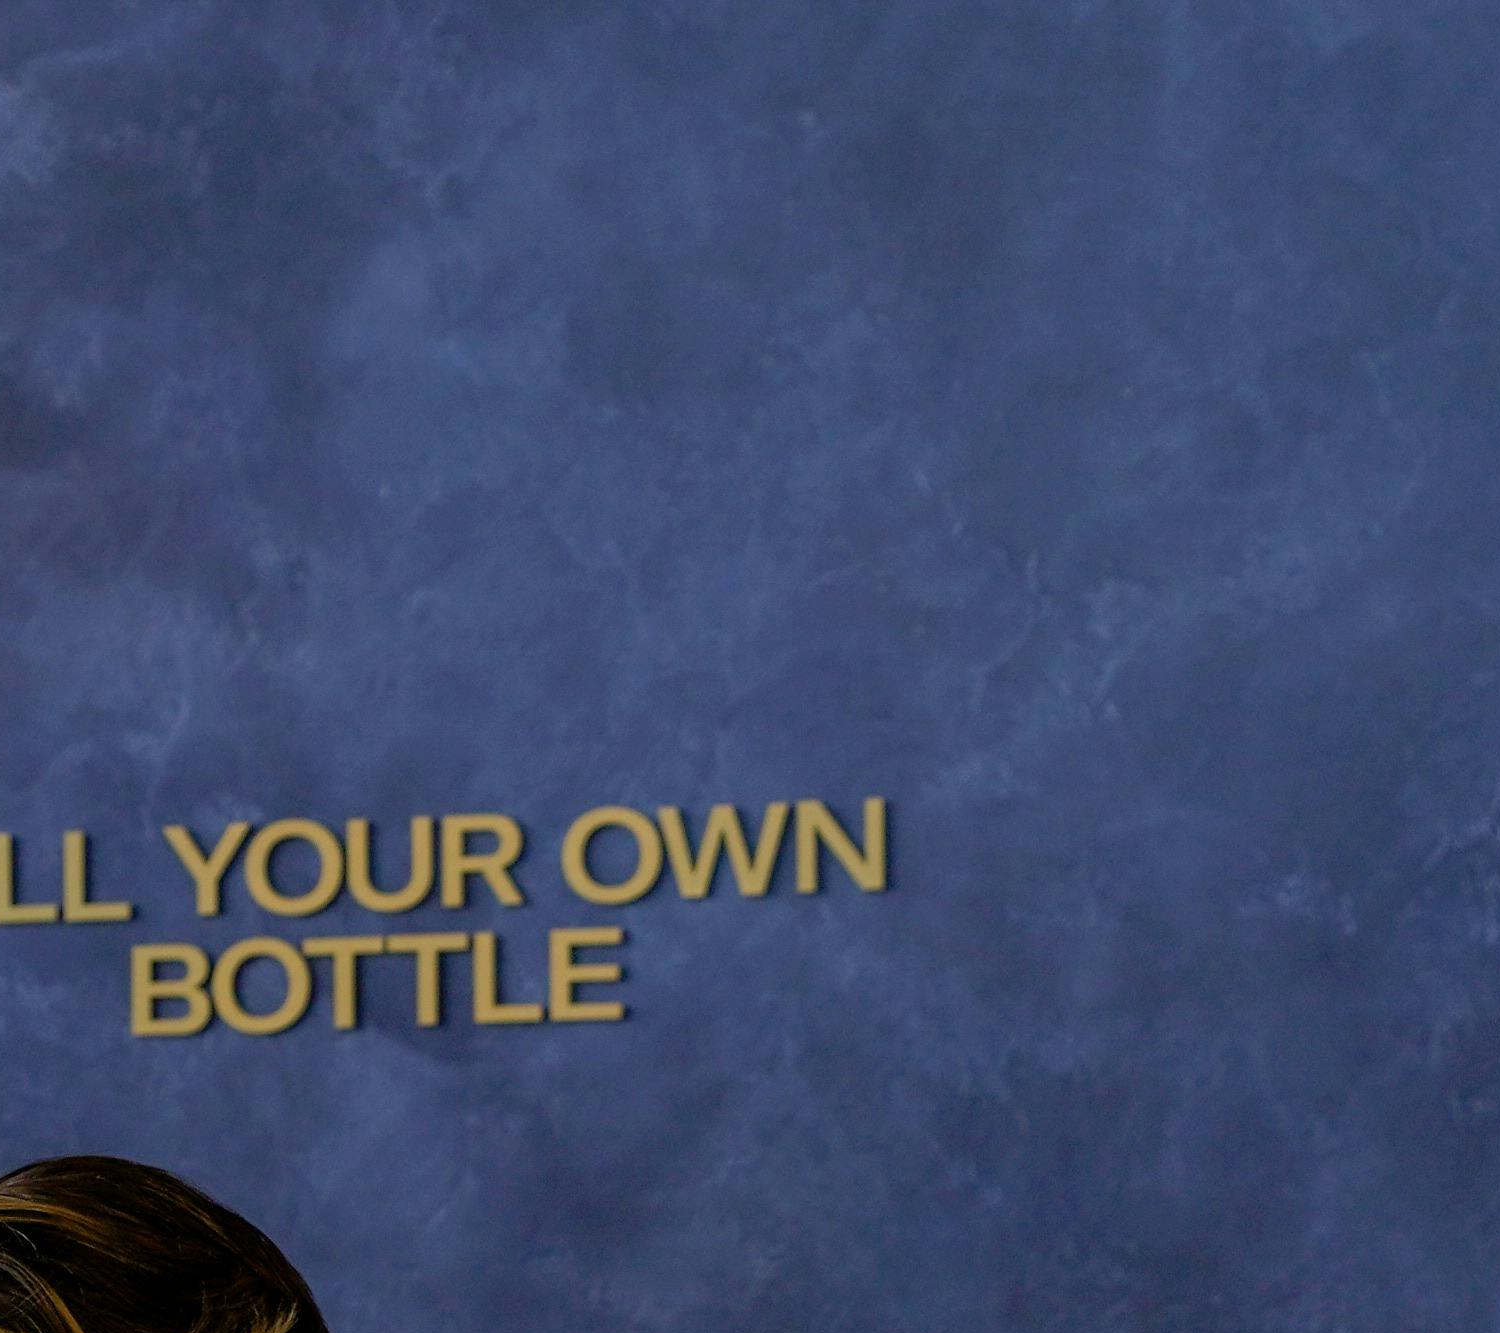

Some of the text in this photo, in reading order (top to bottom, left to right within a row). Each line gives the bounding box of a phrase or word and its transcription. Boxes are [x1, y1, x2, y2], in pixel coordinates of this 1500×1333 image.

[162, 812, 524, 916] YOUR
[561, 797, 887, 904] OWN
[129, 925, 625, 1037] BOTTLE
